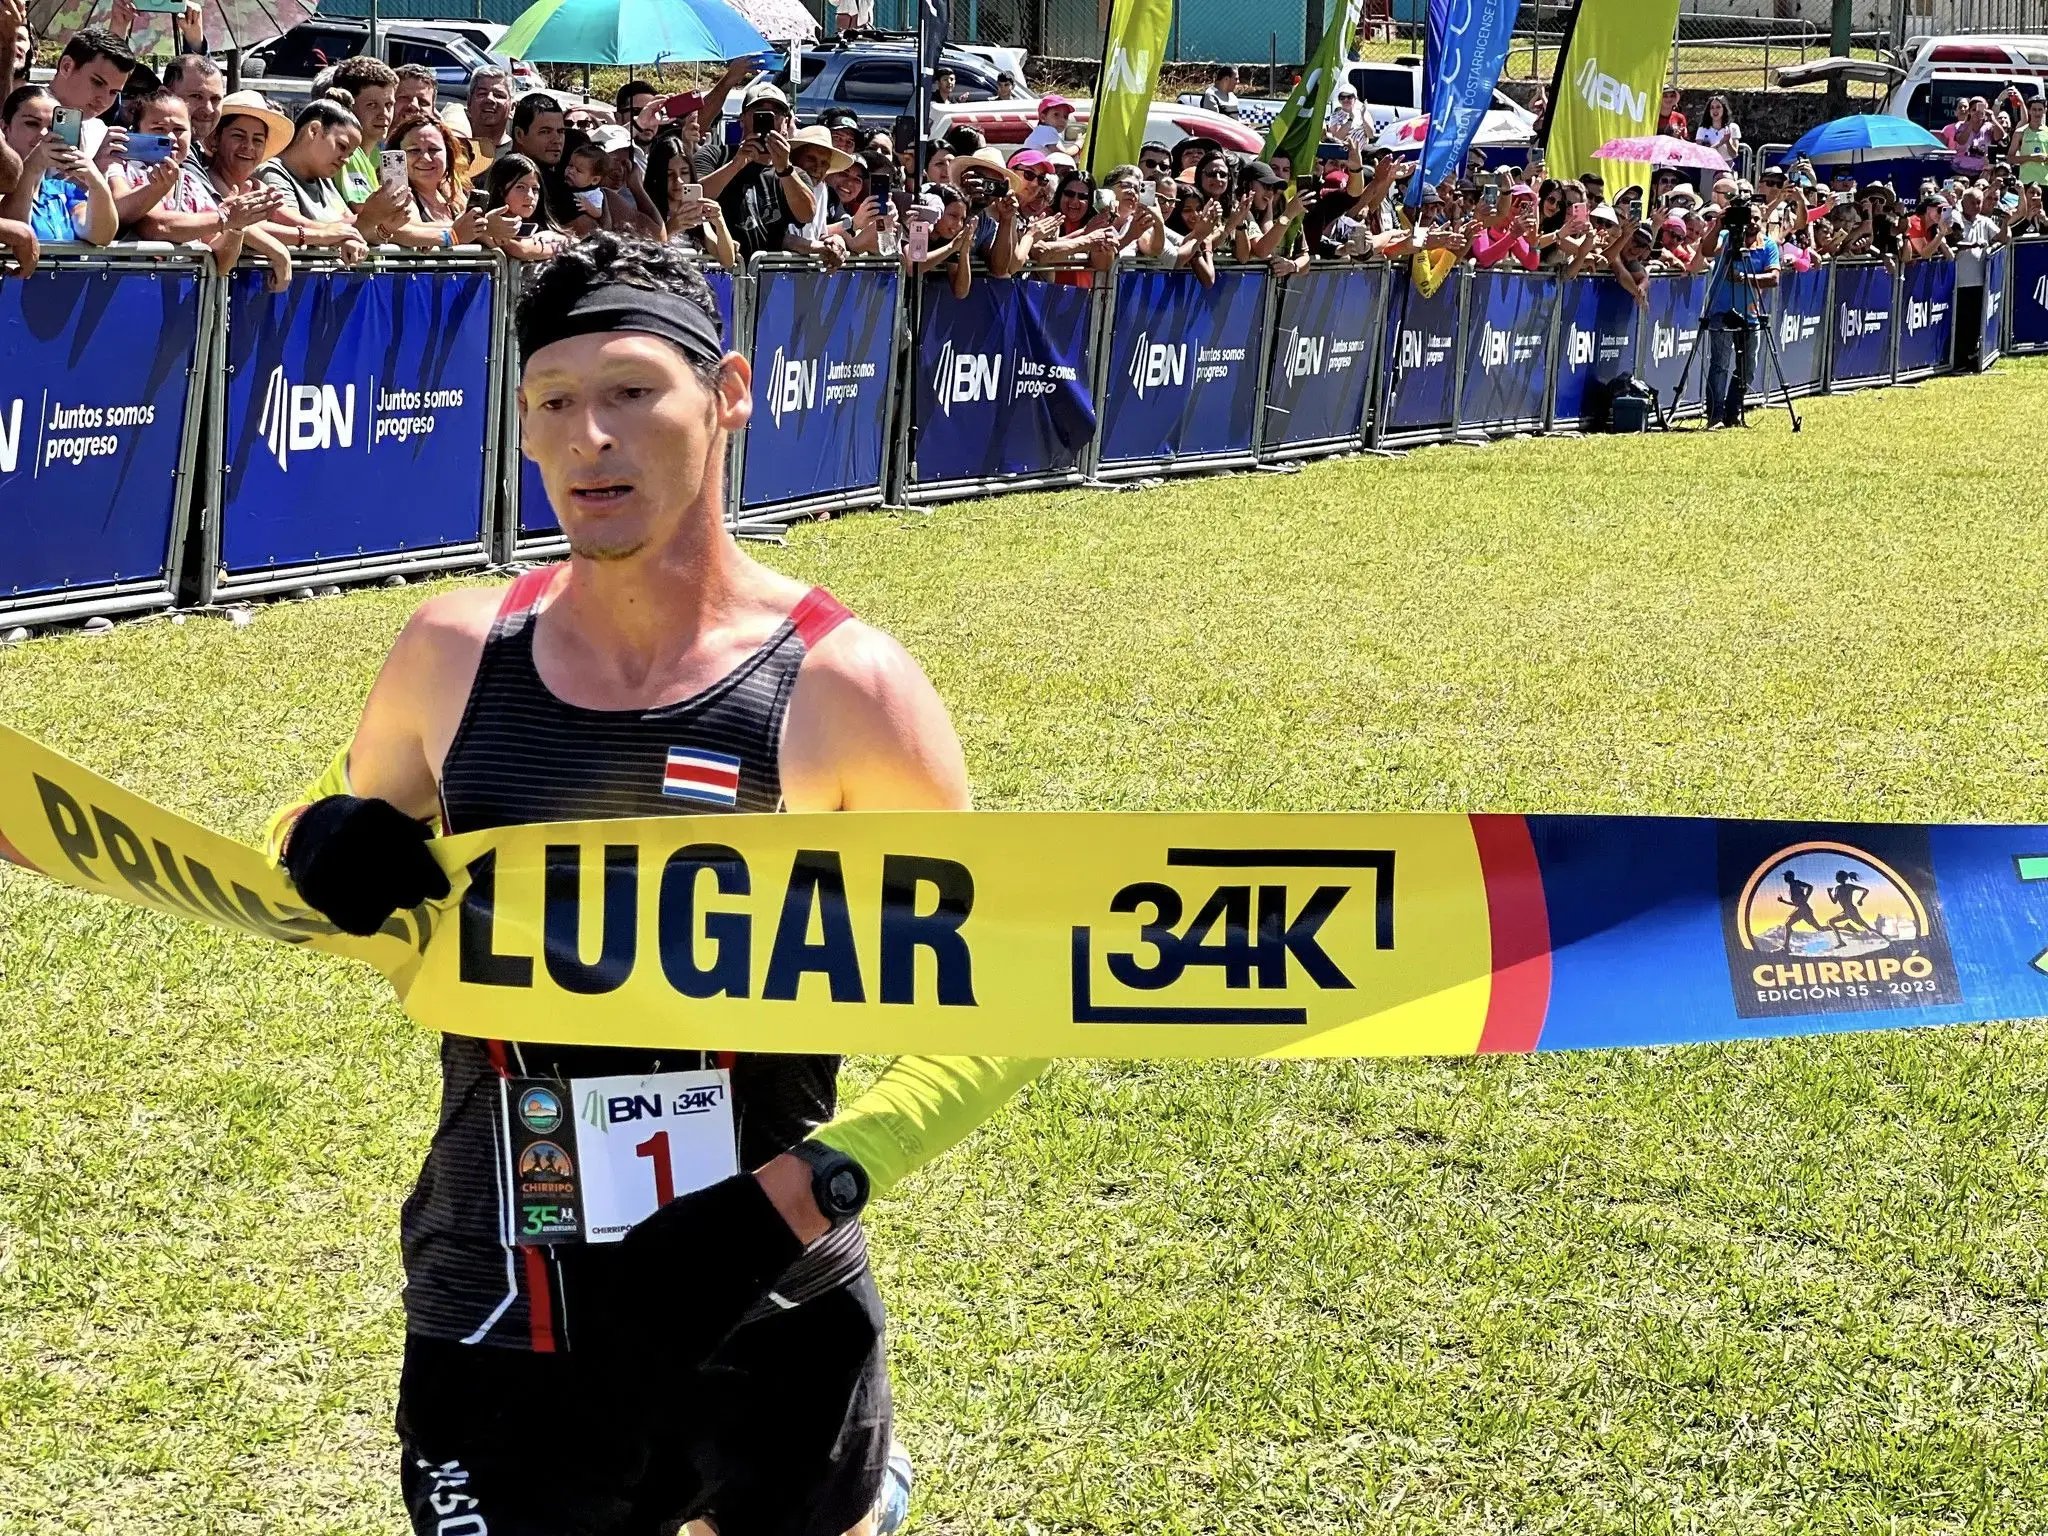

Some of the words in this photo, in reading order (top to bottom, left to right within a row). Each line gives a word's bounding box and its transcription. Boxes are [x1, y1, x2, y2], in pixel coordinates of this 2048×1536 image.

[1464, 6, 1495, 107] COSTARRICENSE
[1597, 72, 1647, 122] BN
[1198, 346, 1221, 362] Juntos
[1222, 348, 1245, 361] somos
[1294, 336, 1325, 376] BN
[1402, 330, 1422, 368] BN
[1490, 331, 1511, 365] BN
[1575, 331, 1596, 363] BN
[828, 361, 851, 380] Juntos
[853, 363, 875, 378] somos
[952, 354, 1002, 402] BN
[1146, 344, 1187, 387] BN
[1196, 365, 1228, 383] progreso
[376, 387, 421, 411] Juntos
[424, 389, 463, 408] somos
[782, 358, 817, 412] BN
[825, 384, 858, 406] progreso
[49, 402, 103, 430] Juntos
[106, 405, 155, 427] somos
[290, 384, 355, 451] BN
[375, 416, 434, 444] progreso
[45, 435, 118, 467] progreso
[459, 843, 979, 1007] LUGAR
[1106, 881, 1357, 990] 34K
[1752, 950, 1933, 988] CHIRRIPÓ
[1757, 985, 1841, 1003] EDICIÓN
[1846, 984, 1869, 998] 35
[1889, 980, 1937, 996] 2023
[608, 1094, 662, 1124] BN
[678, 1090, 717, 1110] 34K
[636, 1131, 675, 1210] 1
[522, 1206, 559, 1235] 35
